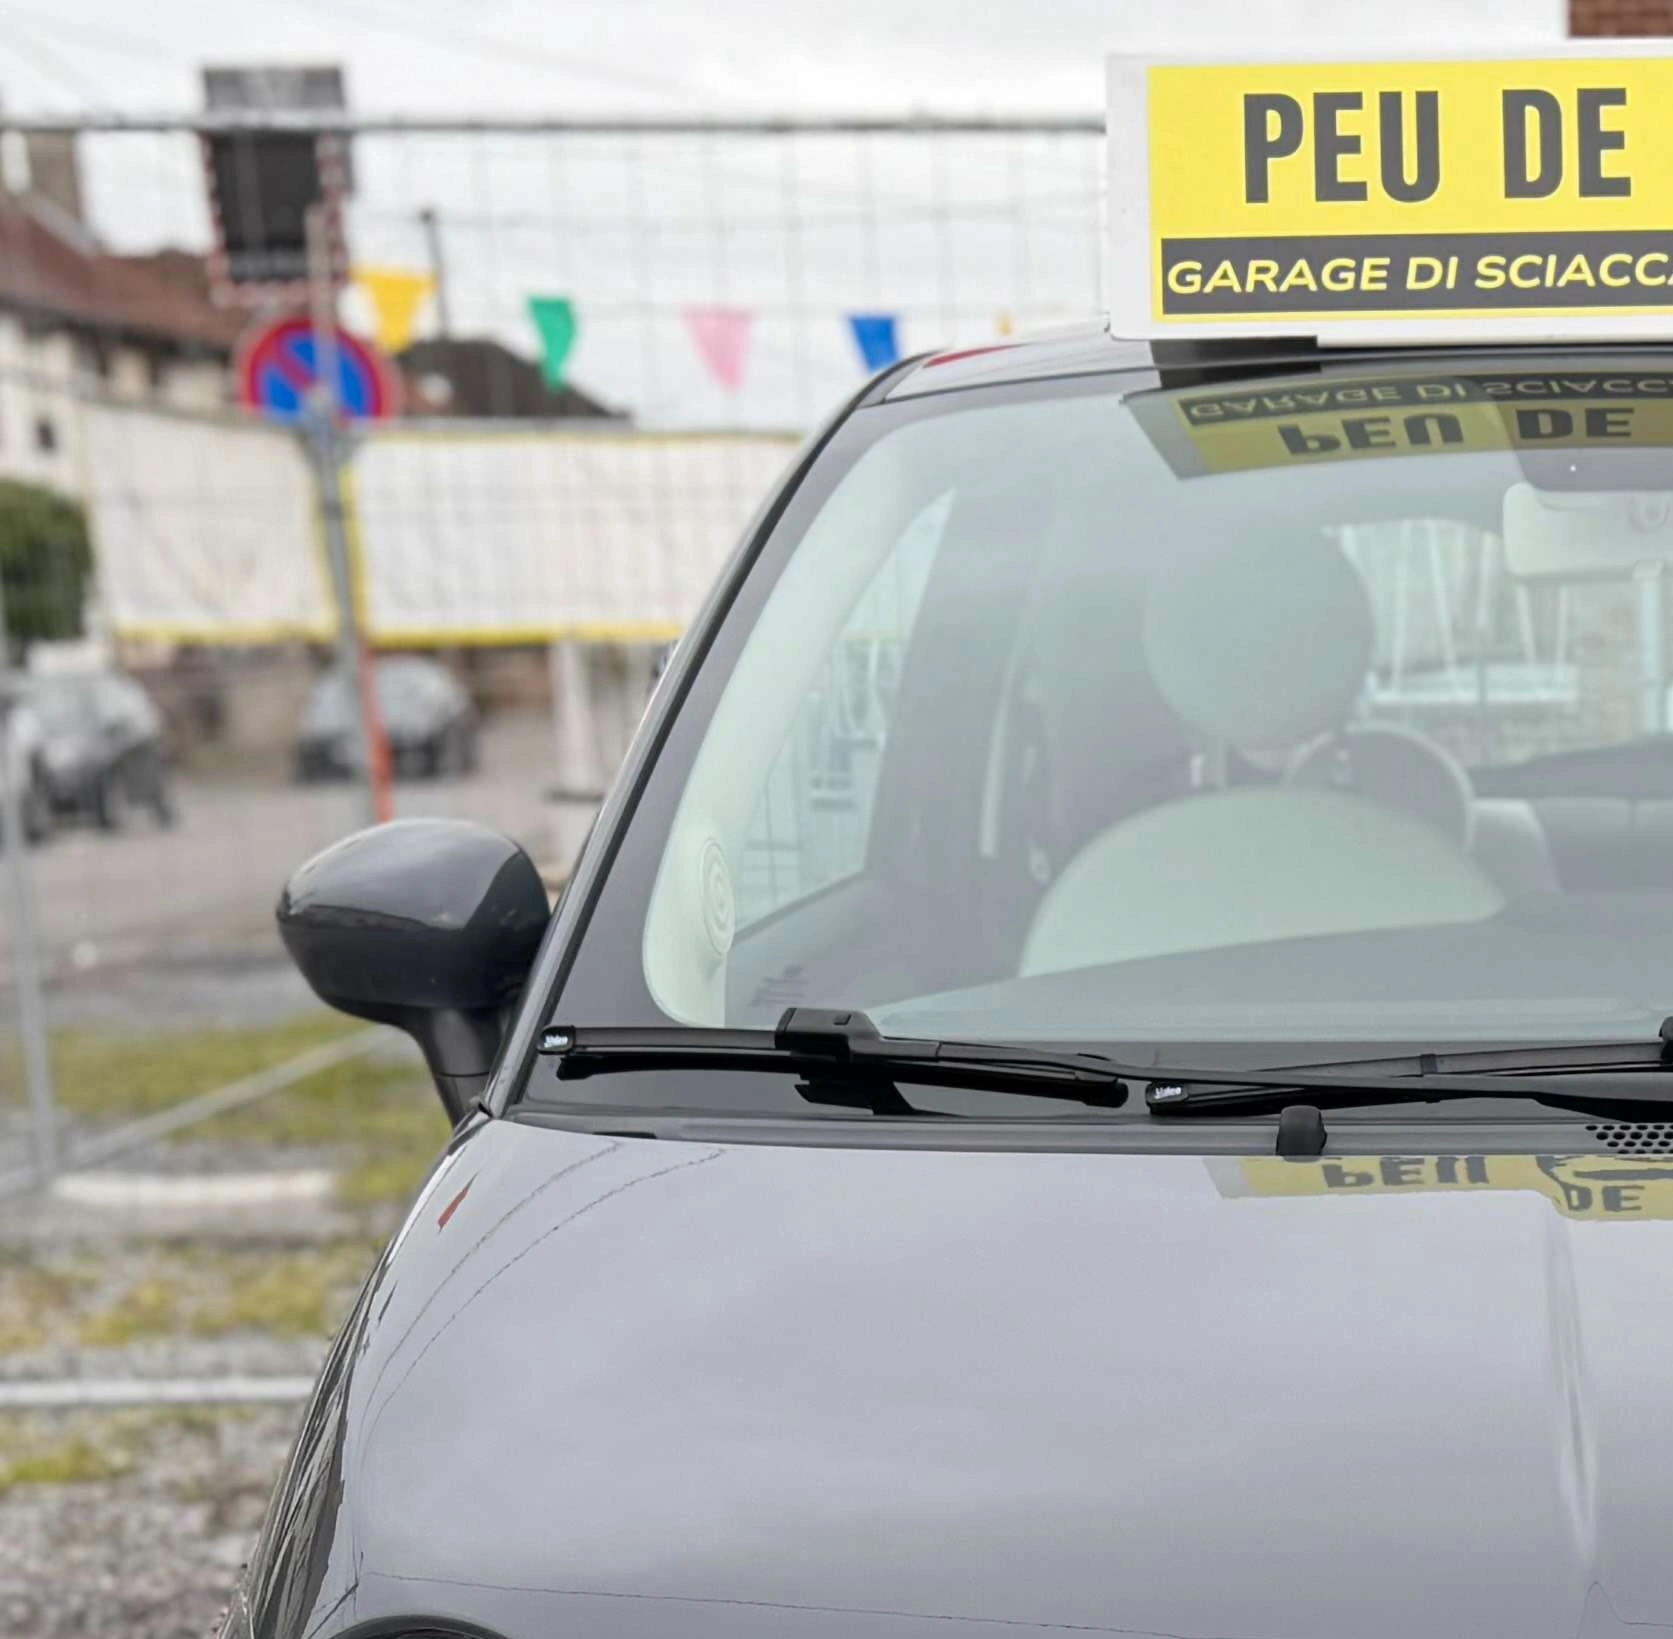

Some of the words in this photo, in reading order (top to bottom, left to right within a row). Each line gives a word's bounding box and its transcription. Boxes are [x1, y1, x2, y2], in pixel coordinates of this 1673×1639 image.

[1243, 90, 1441, 204] PEU
[1501, 87, 1632, 199] DE
[1167, 257, 1391, 294] GARAGE
[1406, 256, 1458, 290] DI
